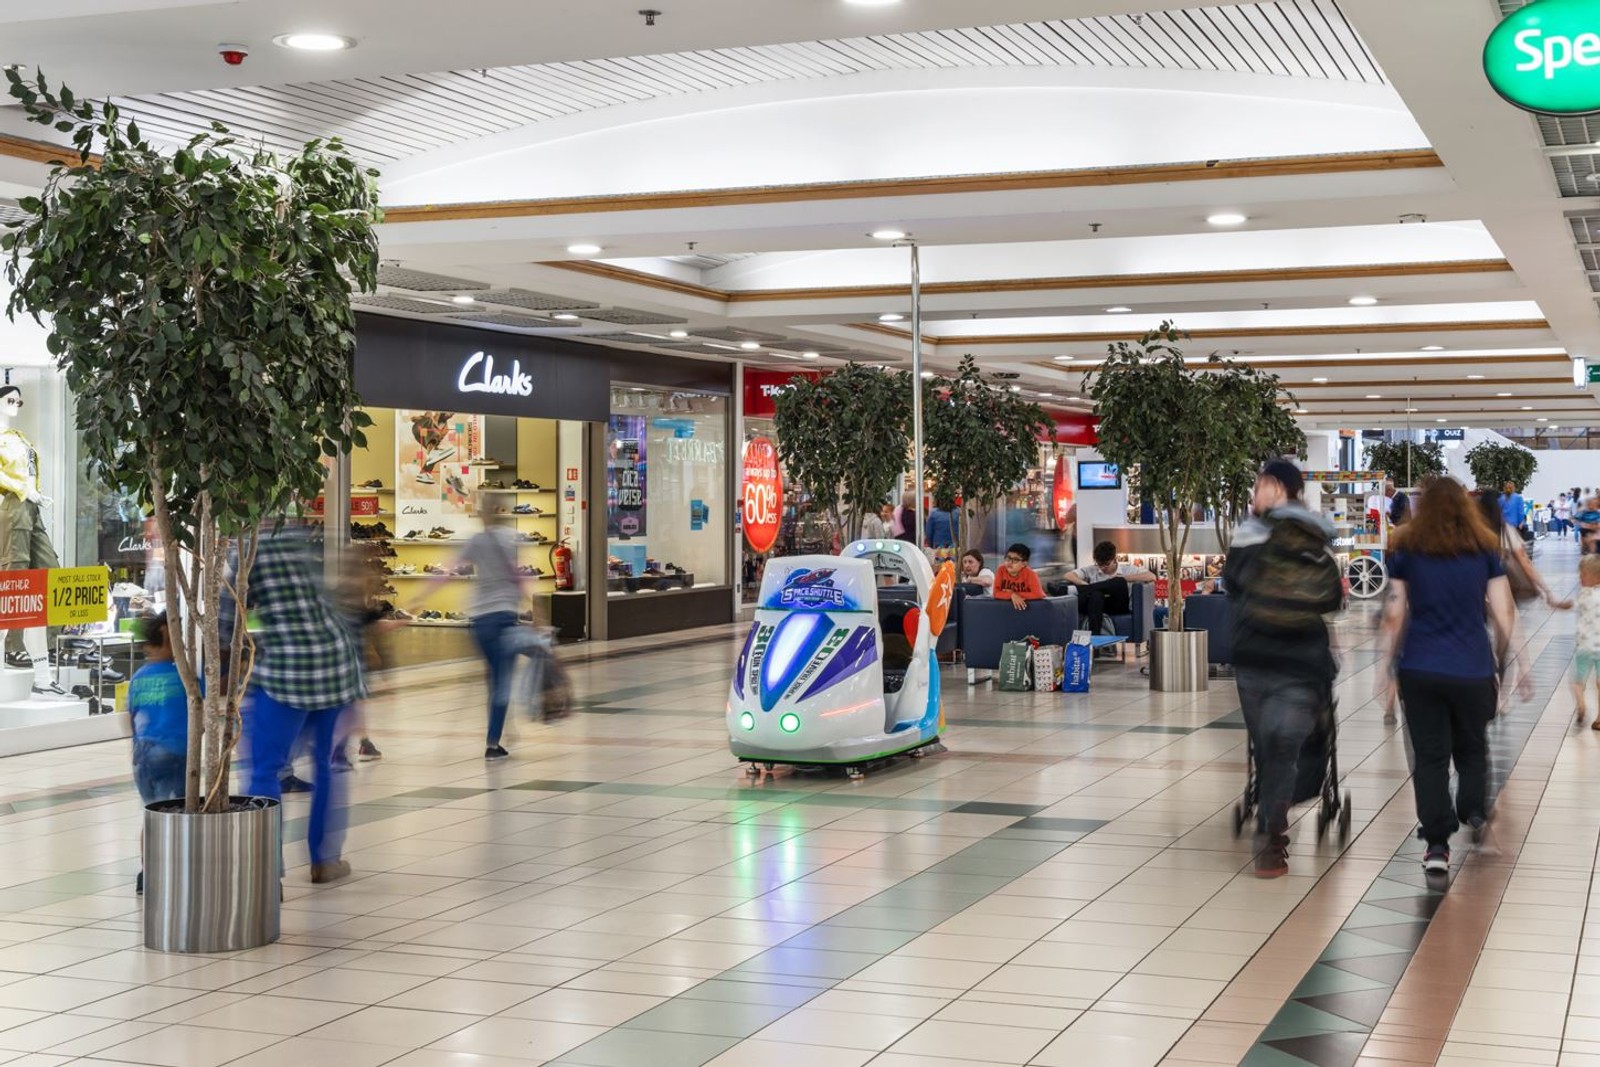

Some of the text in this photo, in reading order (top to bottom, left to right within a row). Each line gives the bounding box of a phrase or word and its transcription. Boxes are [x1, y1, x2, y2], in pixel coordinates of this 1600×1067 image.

[1514, 28, 1600, 80] Spe
[458, 351, 533, 396] Clarks
[402, 505, 428, 515] Clarks
[745, 483, 777, 525] 60%
[766, 509, 777, 524] less
[118, 536, 152, 552] Clarks
[58, 574, 102, 584] MOST SALE STOCK
[53, 586, 104, 607] 1/2 PRICE
[810, 586, 844, 605] SHUTTLE
[1006, 654, 1017, 684] habitat
[1070, 656, 1081, 686] habitat
